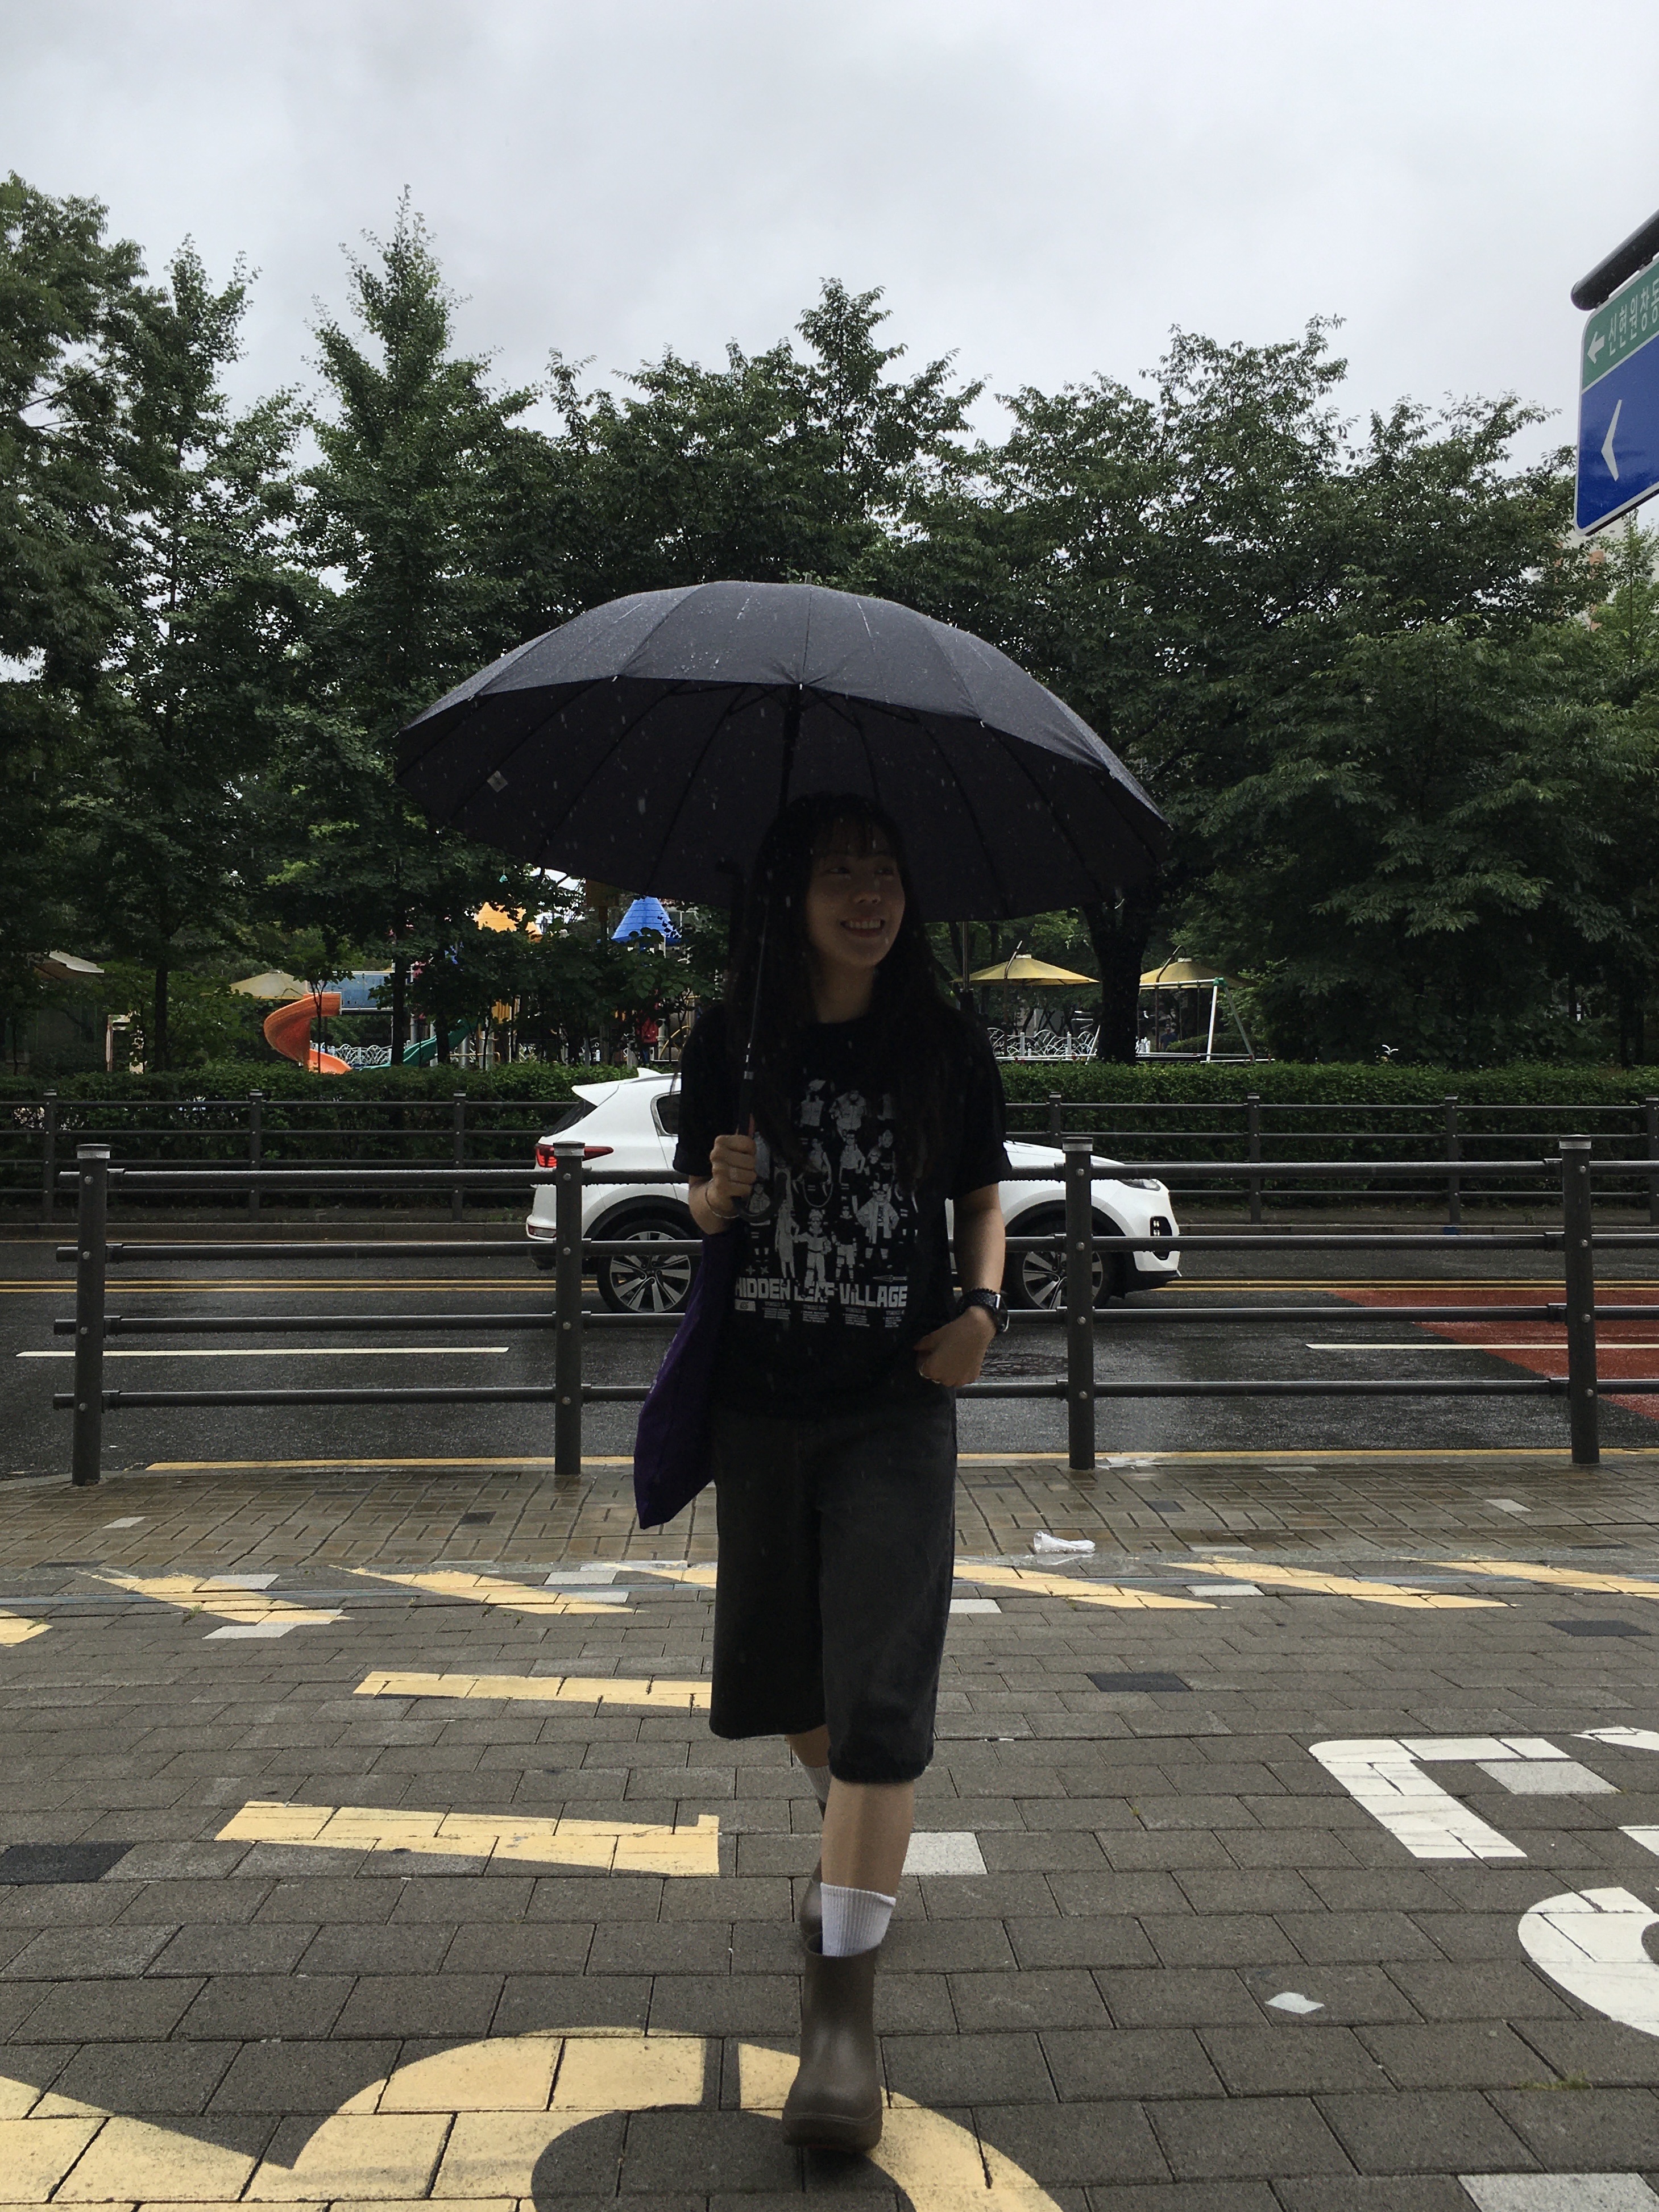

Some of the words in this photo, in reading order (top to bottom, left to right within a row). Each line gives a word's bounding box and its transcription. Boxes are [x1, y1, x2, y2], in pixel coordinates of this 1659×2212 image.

[1608, 277, 1659, 356] 신현원창동
[735, 1277, 791, 1300] HIDDEN
[839, 1283, 908, 1308] VILLAGE
